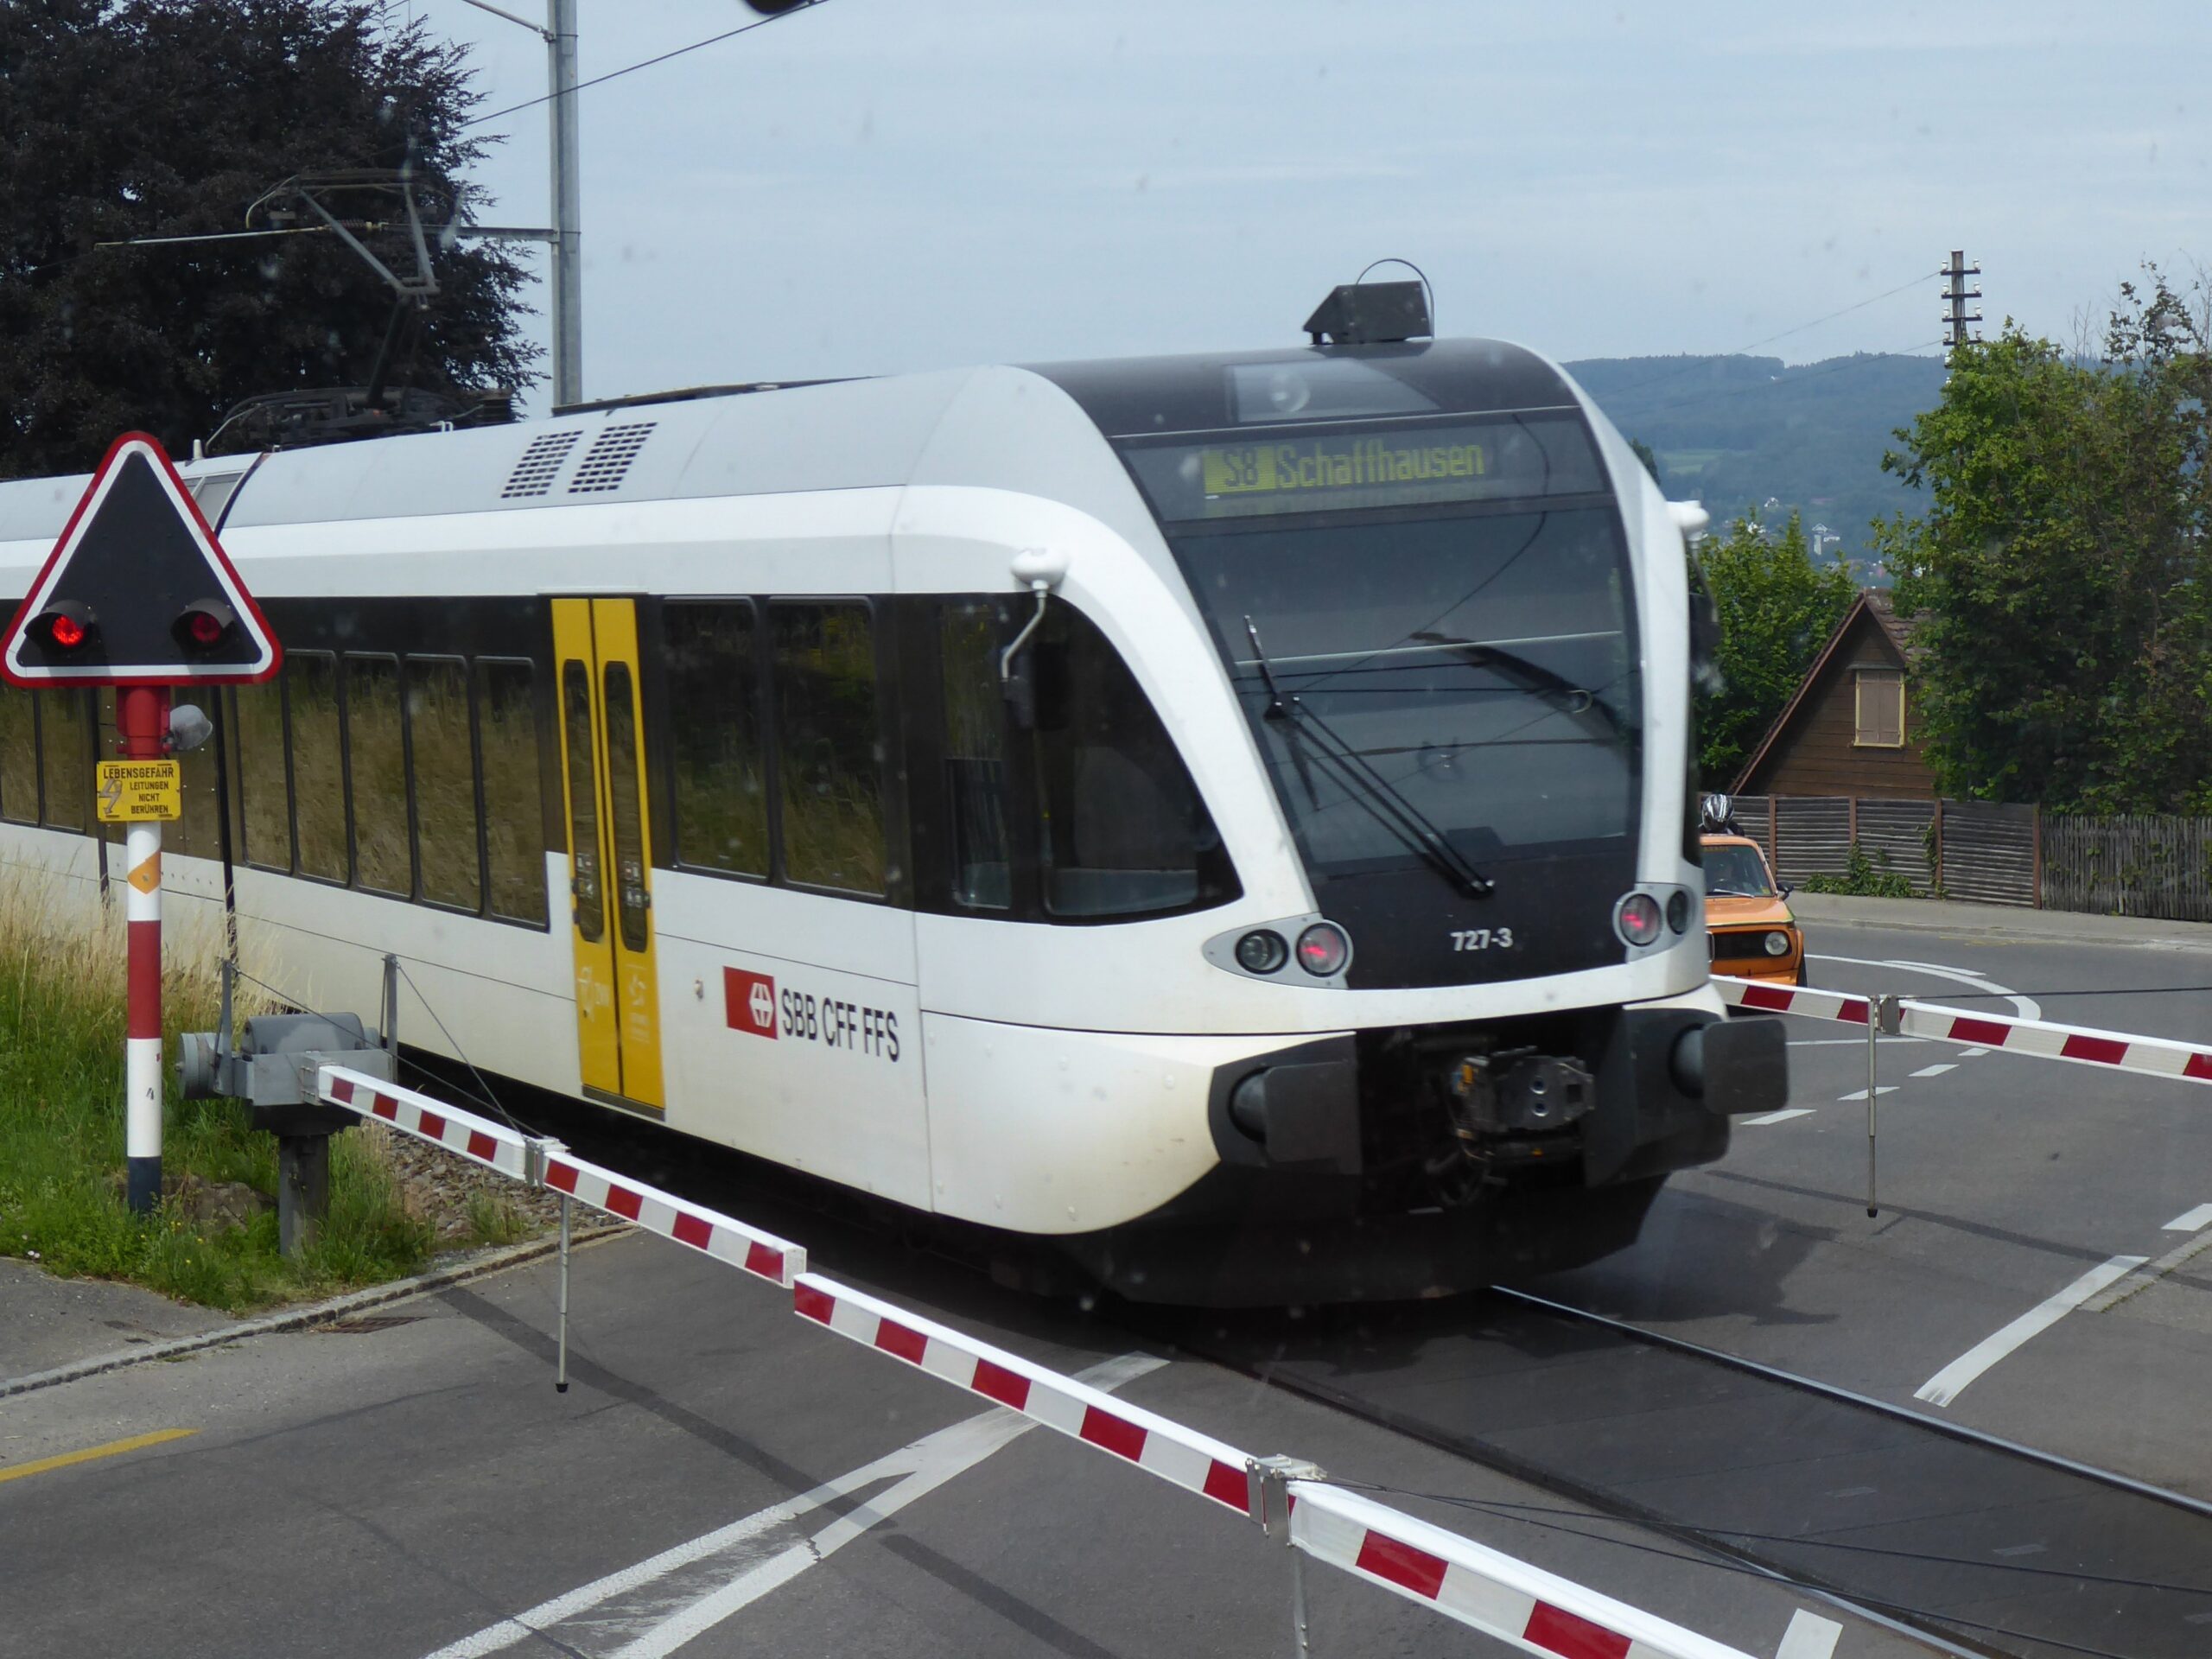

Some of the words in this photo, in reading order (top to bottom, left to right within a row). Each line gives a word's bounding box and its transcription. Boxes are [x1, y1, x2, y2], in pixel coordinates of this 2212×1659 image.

[1223, 448, 1258, 486] S8
[1277, 439, 1484, 488] Schaffhausen
[104, 766, 174, 779] LEBENSGEFAHR
[130, 781, 168, 791] LEITUNGEN
[138, 793, 160, 802] NICHT
[130, 804, 168, 814] BERÜHREN
[1450, 927, 1513, 950] 727-3
[781, 988, 817, 1040] SBB
[822, 997, 857, 1050] CFF
[862, 1007, 900, 1063] FFS
